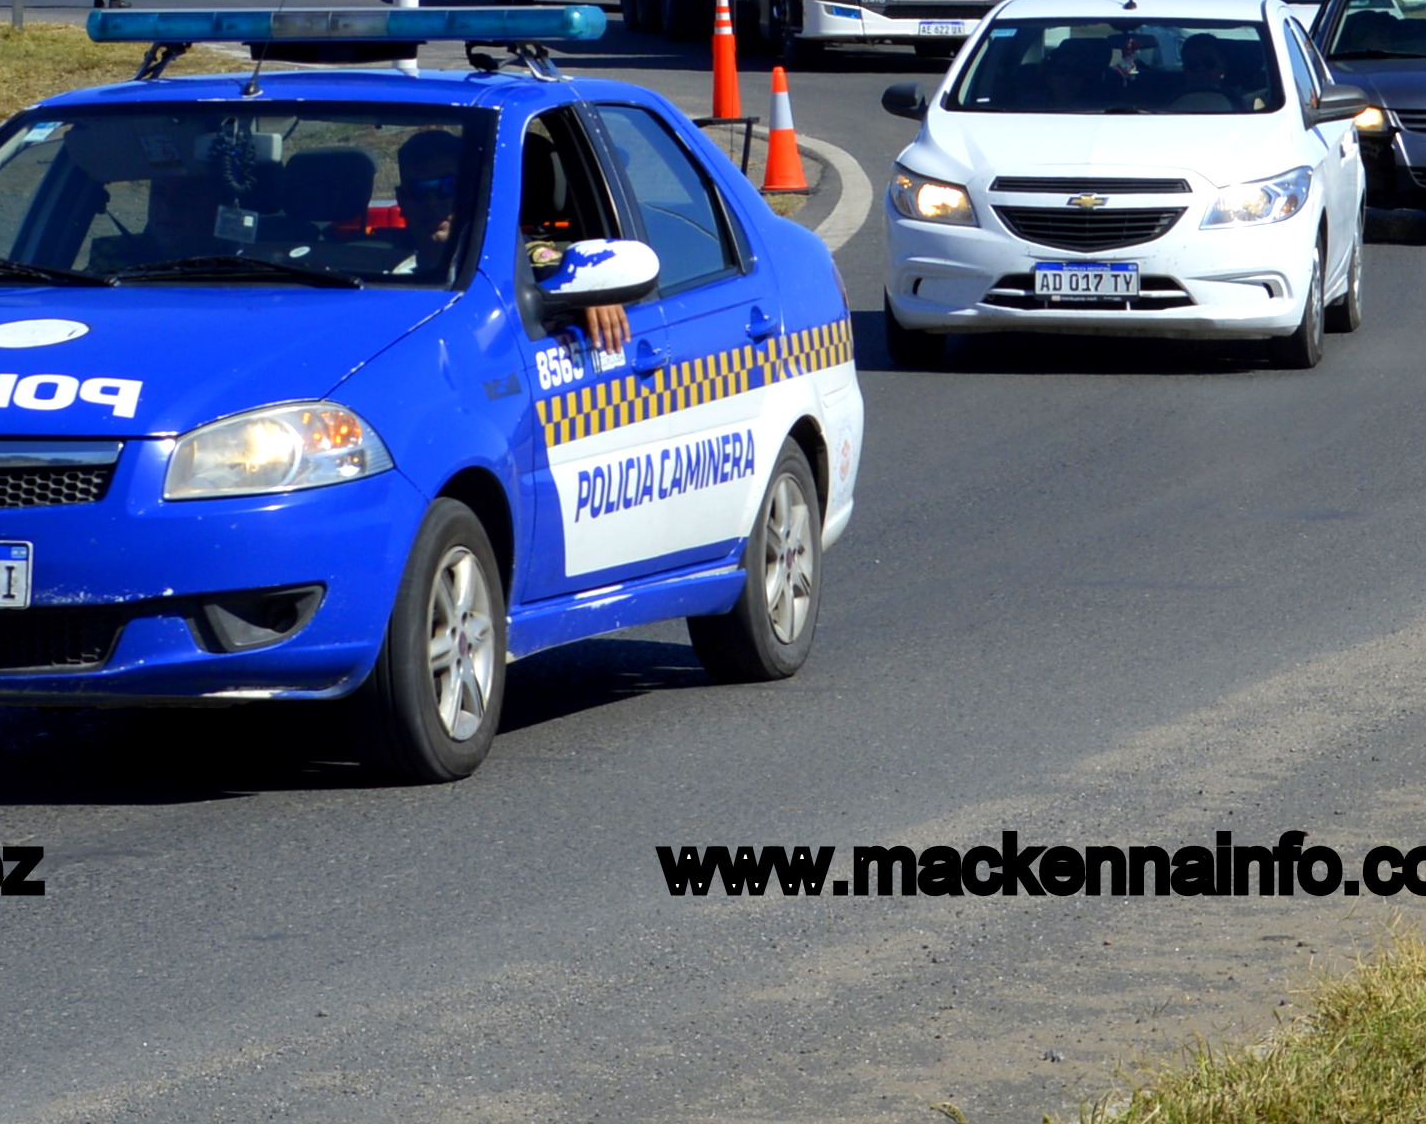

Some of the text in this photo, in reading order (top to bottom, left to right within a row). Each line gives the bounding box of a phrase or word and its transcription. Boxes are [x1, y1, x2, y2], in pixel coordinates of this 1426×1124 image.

[1040, 273, 1133, 292] AD 017 TY
[574, 428, 755, 523] POLICIA CAMINERA
